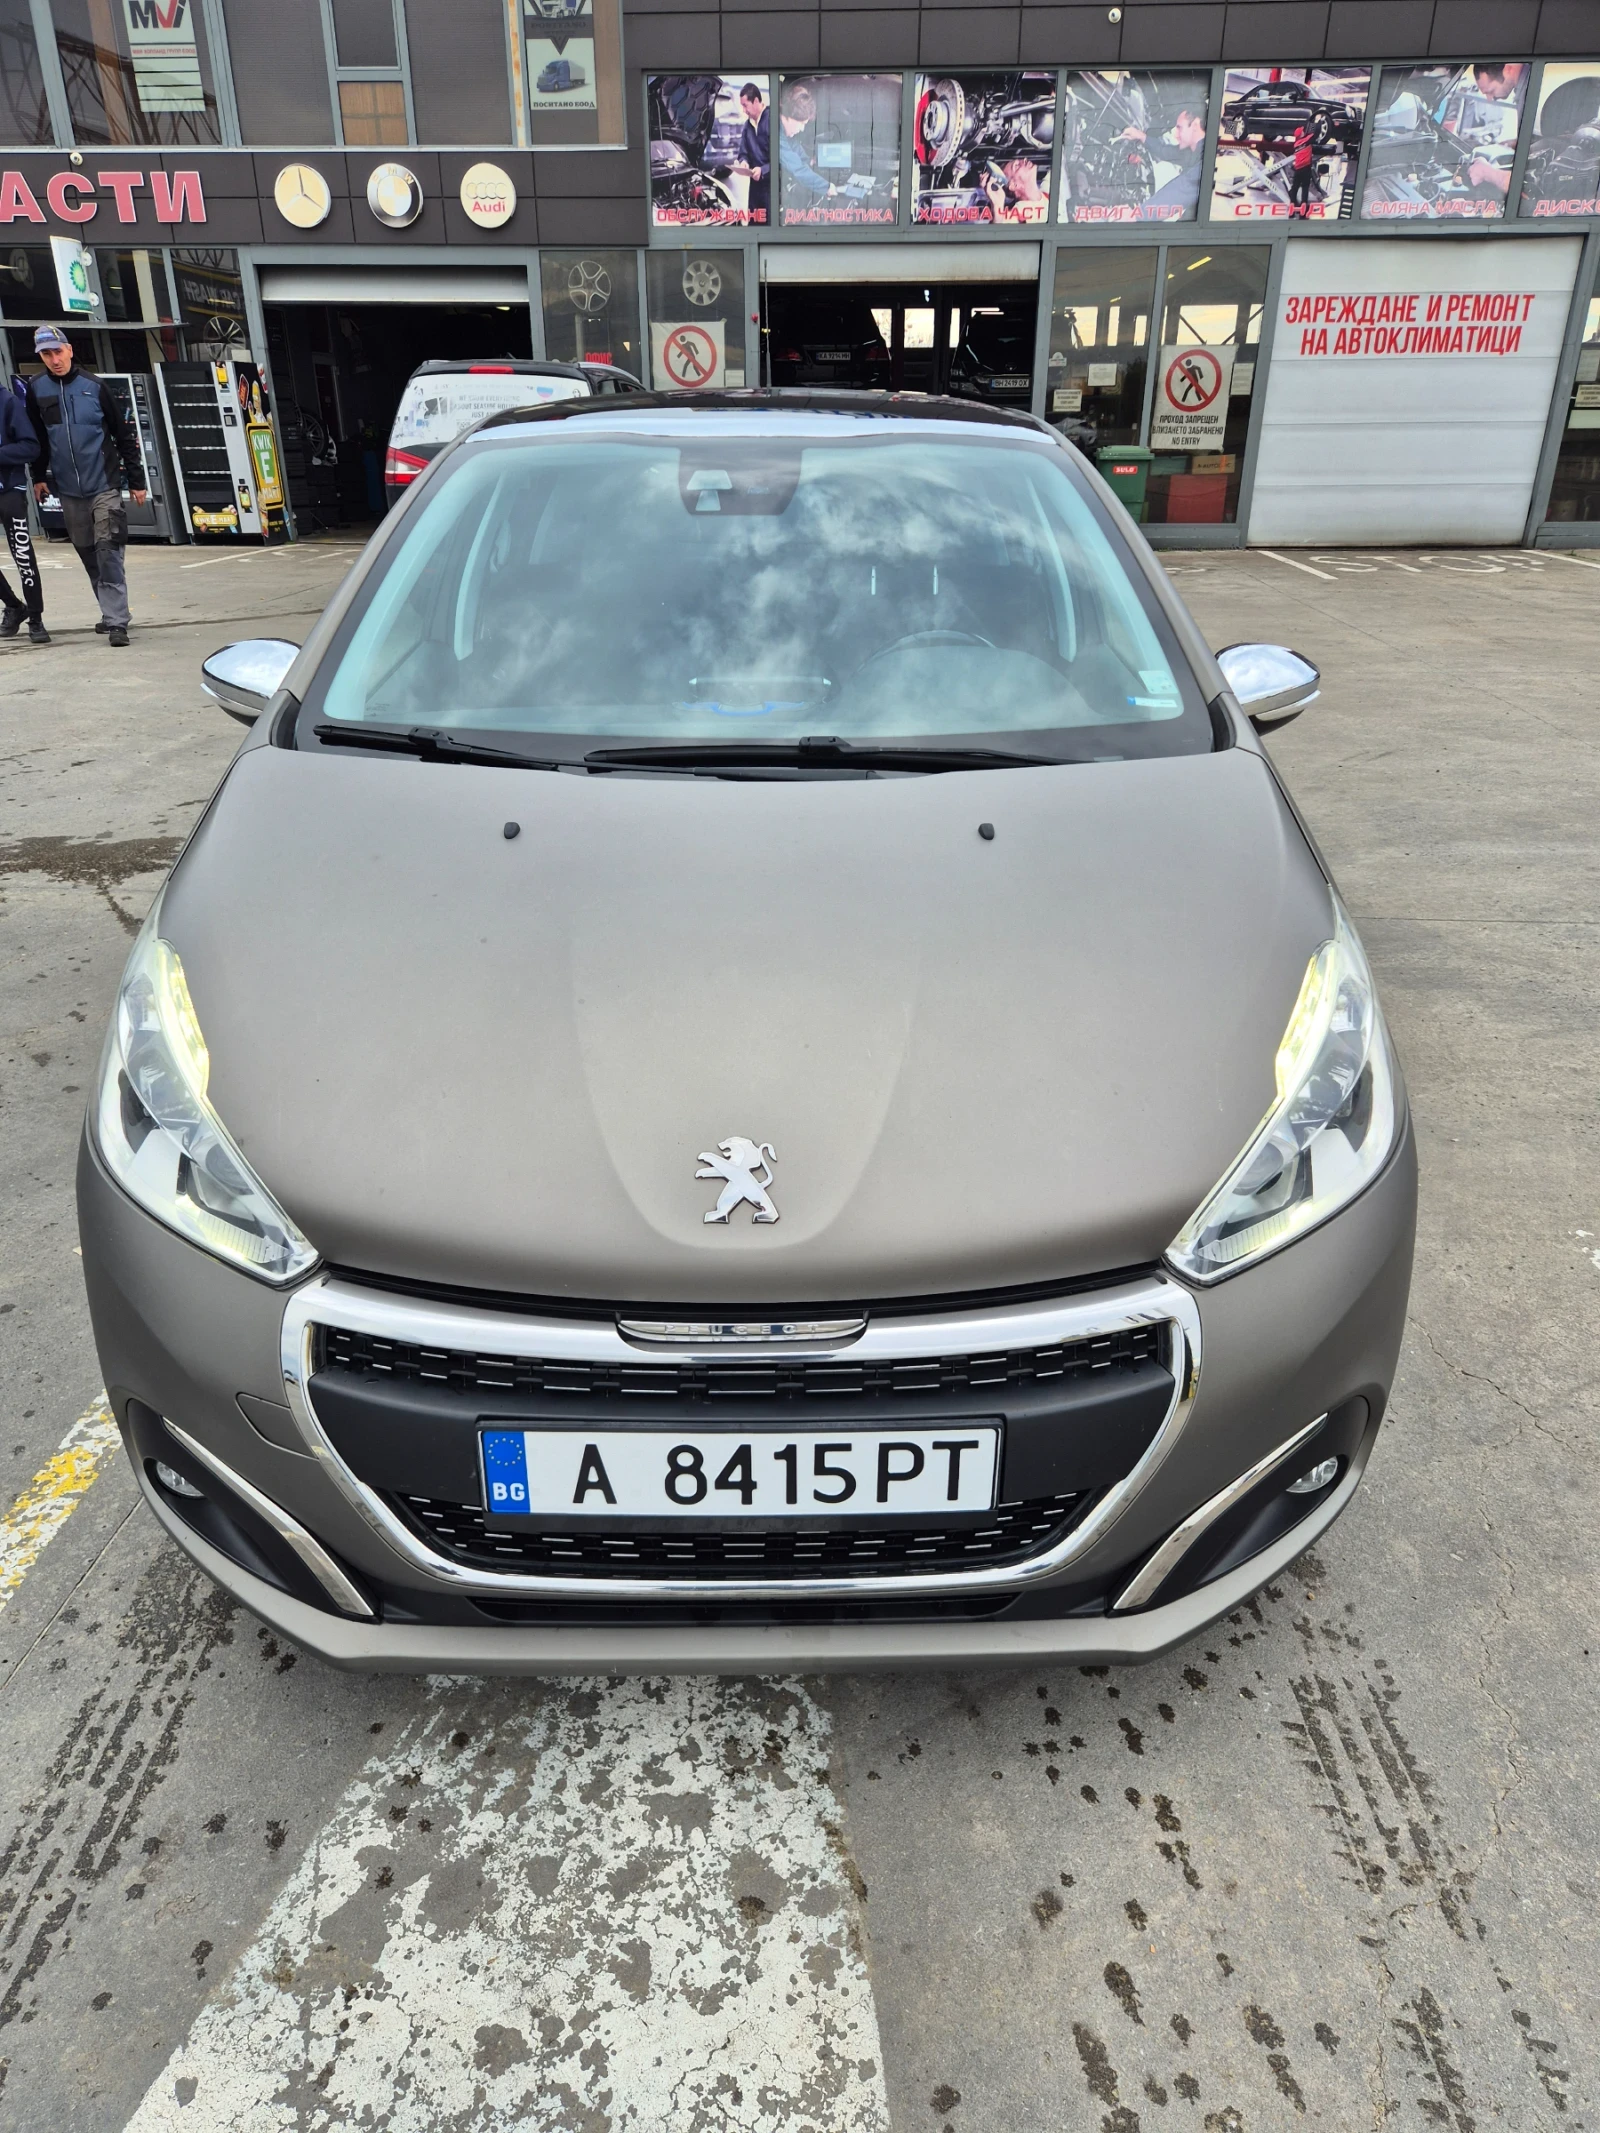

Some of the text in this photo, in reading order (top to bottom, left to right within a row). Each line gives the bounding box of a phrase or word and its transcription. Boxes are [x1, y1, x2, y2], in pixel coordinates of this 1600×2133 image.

[372, 166, 414, 185] BMW
[472, 201, 506, 213] Audi
[919, 205, 1045, 222] ХОДОВА ЧАСТ
[1075, 205, 1184, 222] ДВИГАТЕЛ
[1234, 203, 1326, 219] СТЕНД
[1370, 200, 1497, 215] СМЯНА МАСЛА
[657, 208, 767, 223] ОБСЛУЖВАНЕ
[785, 208, 894, 223] ДИАГНОСТИКА
[1285, 294, 1535, 325] ЗАРЕЖДАНЕ И РЕМОНТ
[1300, 326, 1522, 356] НА АВТОКЛИМАТИЦИ
[1160, 415, 1219, 424] ПРОХОД ЗАПРЕЩЕН
[1188, 426, 1224, 435] ЗАБРАНЕНО
[252, 433, 272, 450] KWIK
[1171, 437, 1201, 445] NO ENTRY
[260, 451, 274, 484] E
[262, 485, 280, 499] MART
[665, 1324, 820, 1335] PEUGEOT
[572, 1440, 979, 1505] A 8415 PT
[493, 1482, 525, 1502] BG
